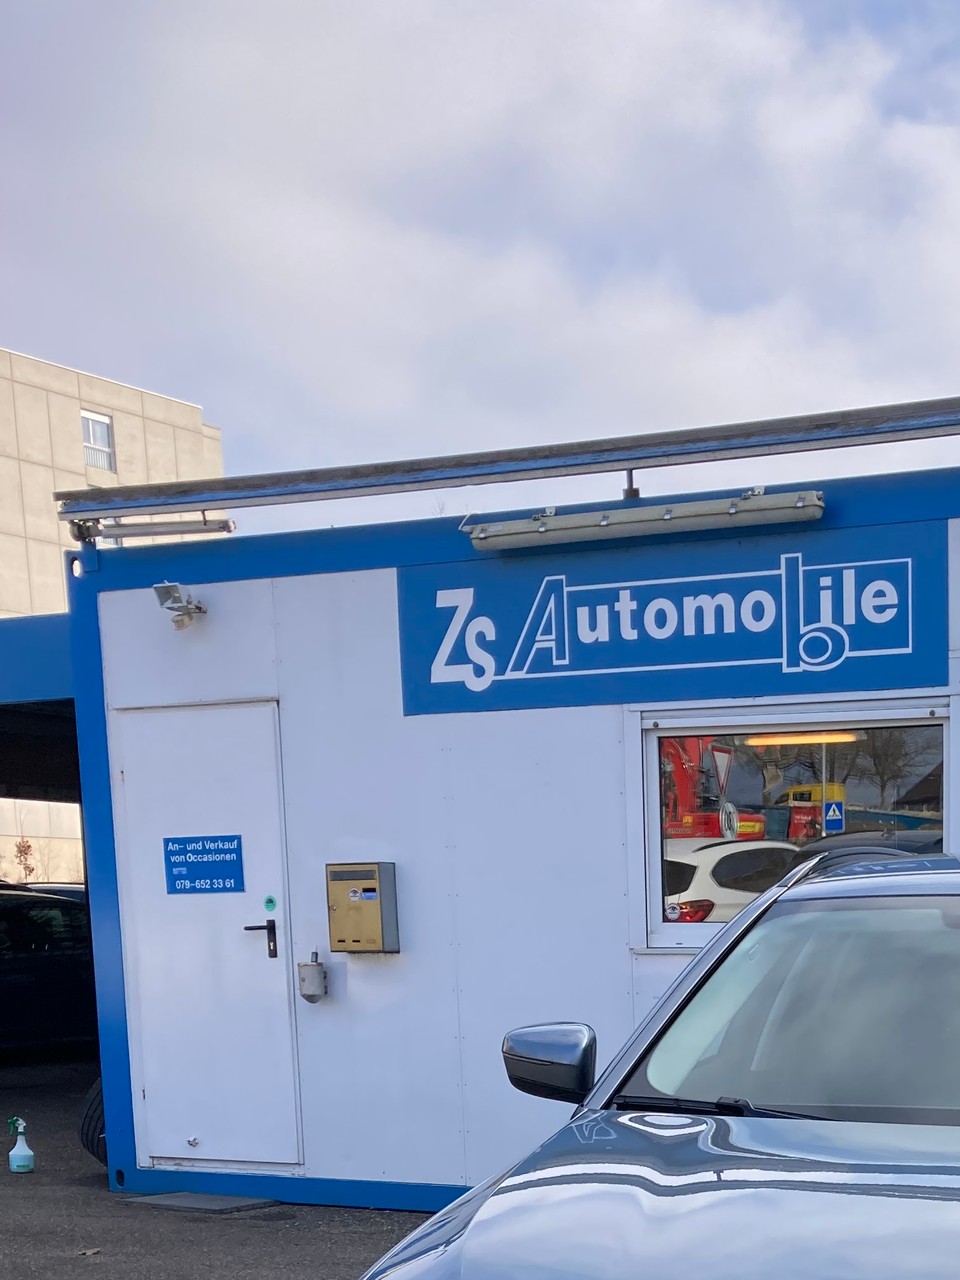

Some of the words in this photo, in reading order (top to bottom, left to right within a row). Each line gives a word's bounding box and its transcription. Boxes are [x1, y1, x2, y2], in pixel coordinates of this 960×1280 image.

[505, 553, 899, 677] Automobile
[186, 841, 202, 850] und
[204, 839, 238, 850] Verkauf
[170, 855, 185, 863] von
[186, 852, 237, 862] Occasionen
[212, 879, 223, 888] 33
[225, 879, 235, 888] 61
